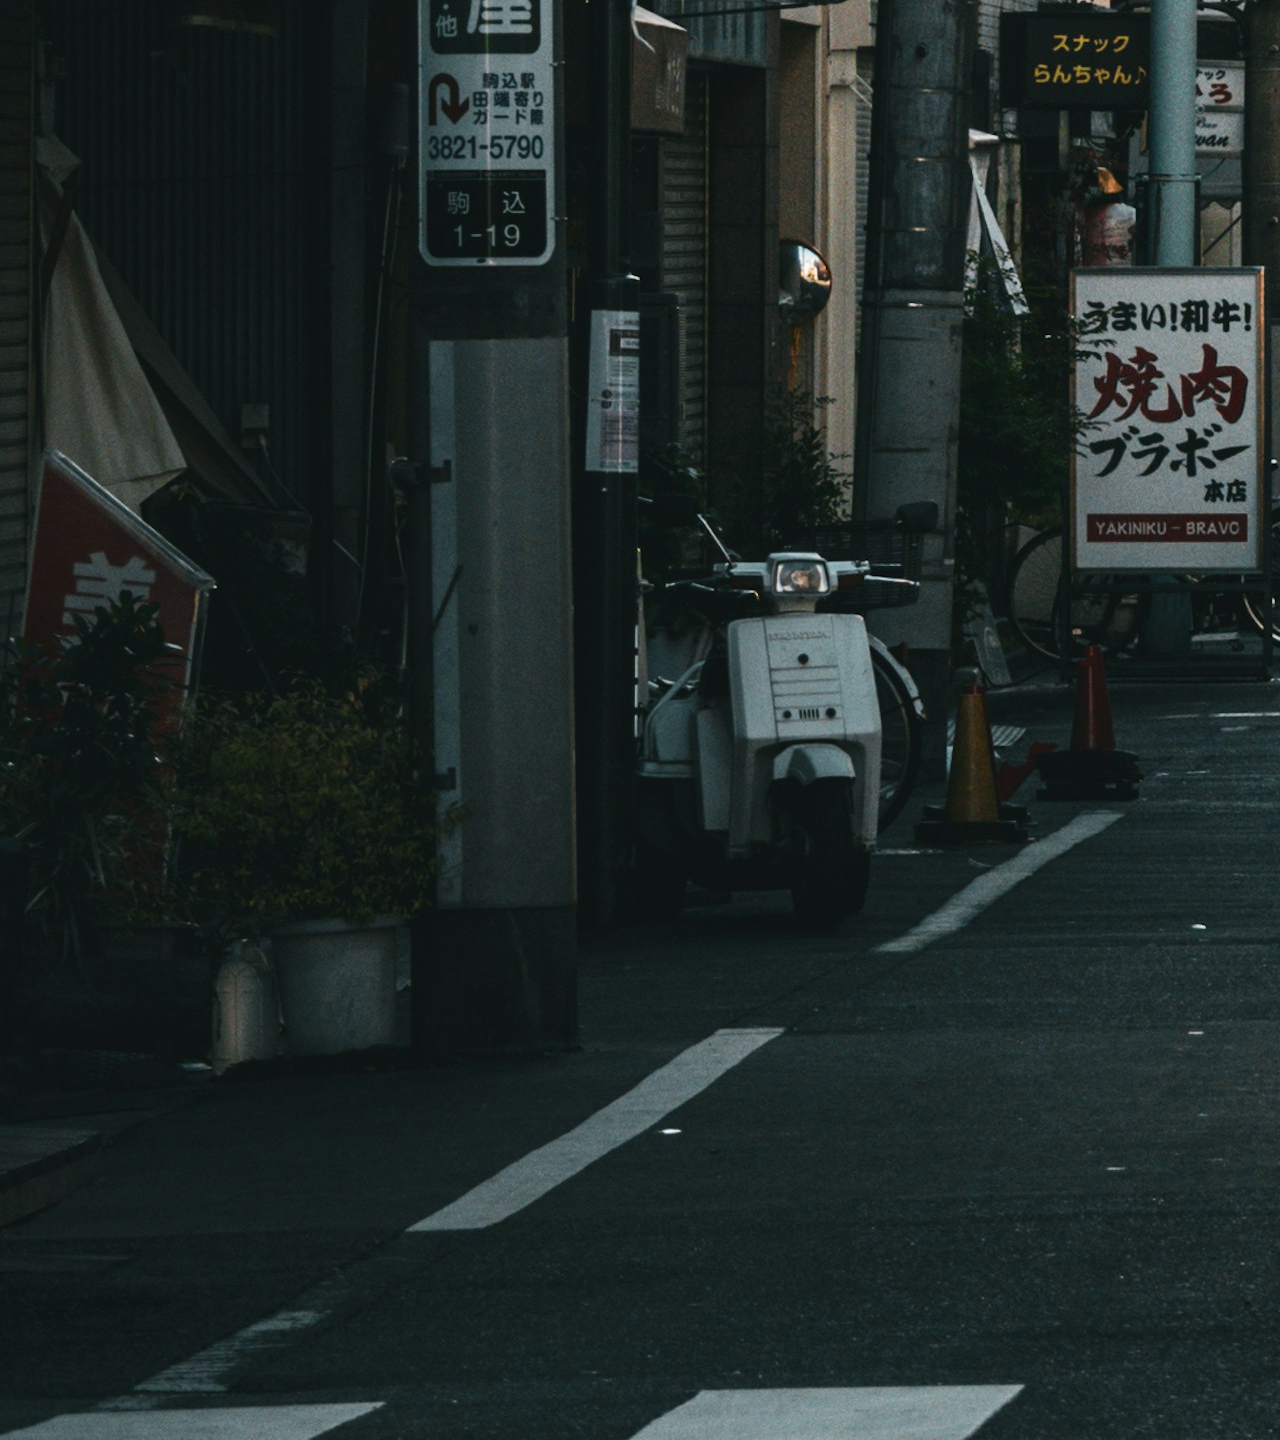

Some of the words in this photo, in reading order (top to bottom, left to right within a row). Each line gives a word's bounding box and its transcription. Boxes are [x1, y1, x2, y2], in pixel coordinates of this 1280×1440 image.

[1052, 33, 1130, 53] スナック
[482, 72, 535, 89] 駒込駅
[472, 91, 544, 108] 田端寄り
[428, 134, 544, 161] 3821-5790
[447, 190, 526, 215] 駒込
[453, 223, 521, 247] 1-19
[1086, 343, 1249, 425] 焼肉
[1089, 423, 1251, 478] ブラボー
[1203, 479, 1248, 503] 本店
[1095, 521, 1168, 536] YAKINIKU
[1185, 521, 1240, 536] BRAVO
